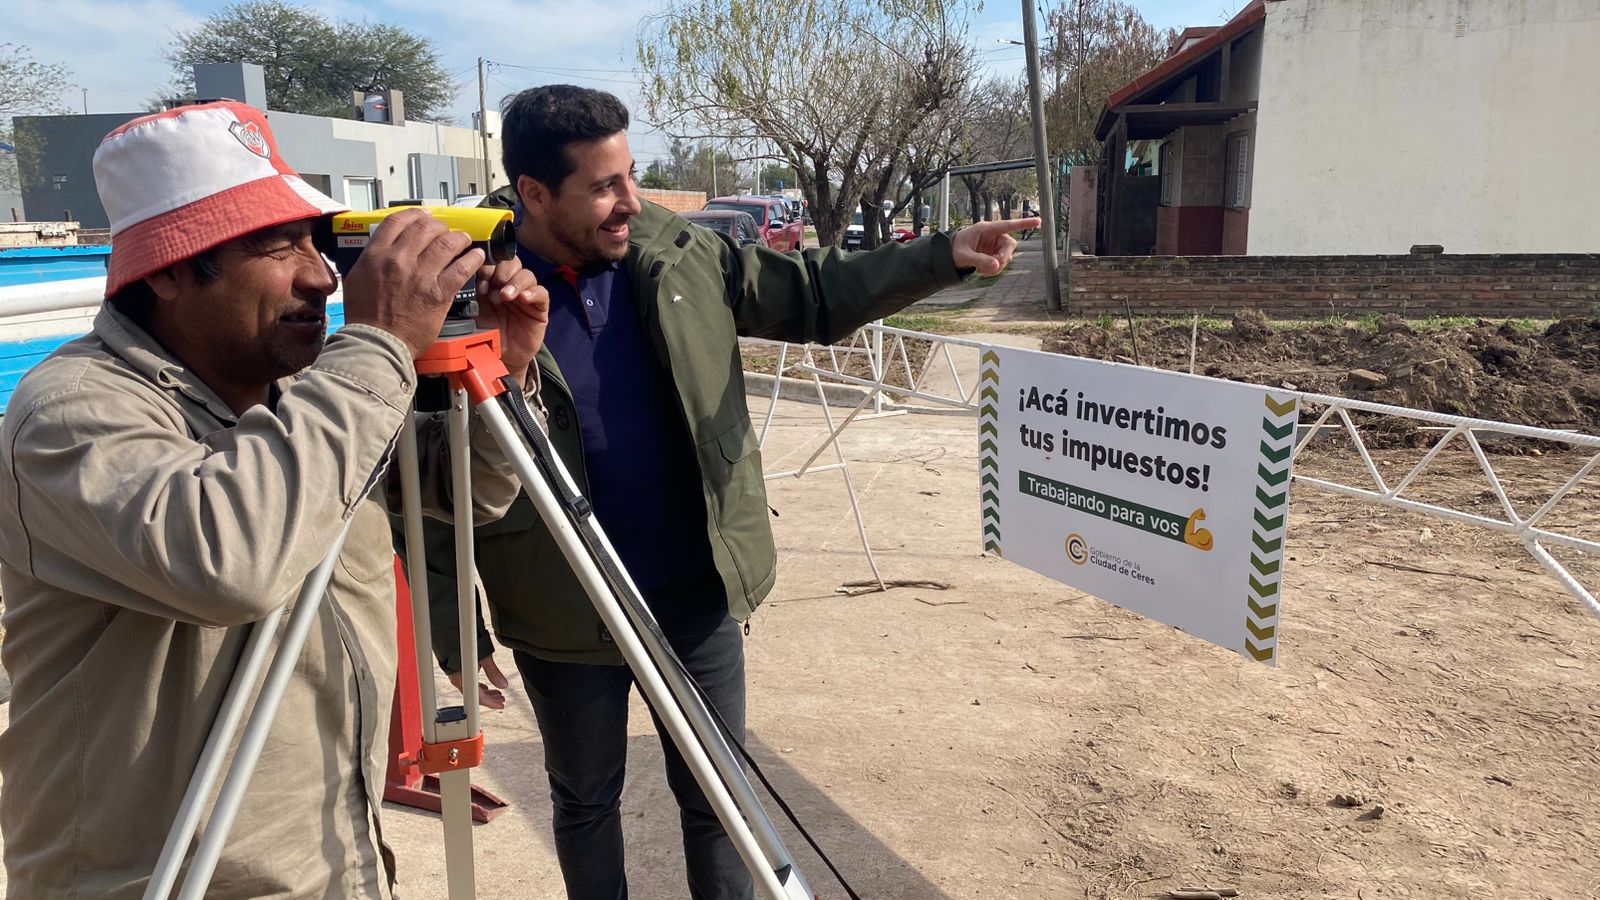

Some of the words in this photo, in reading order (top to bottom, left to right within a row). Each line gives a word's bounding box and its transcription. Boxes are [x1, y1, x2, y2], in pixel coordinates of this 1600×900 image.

[341, 219, 363, 230] Leica
[1018, 386, 1068, 416] ¡Acá
[1076, 391, 1227, 449] invertimos
[1019, 424, 1054, 453] tus
[1062, 429, 1211, 492] impuestos!
[1027, 476, 1106, 513] Trabajando
[1109, 503, 1145, 526] para
[1150, 515, 1180, 536] vos
[1090, 547, 1122, 564] Gobierno
[1122, 559, 1133, 569] de
[1134, 562, 1141, 571] la
[1090, 555, 1117, 572] Ciudad
[1118, 566, 1129, 576] de
[1131, 570, 1155, 585] Ceres
